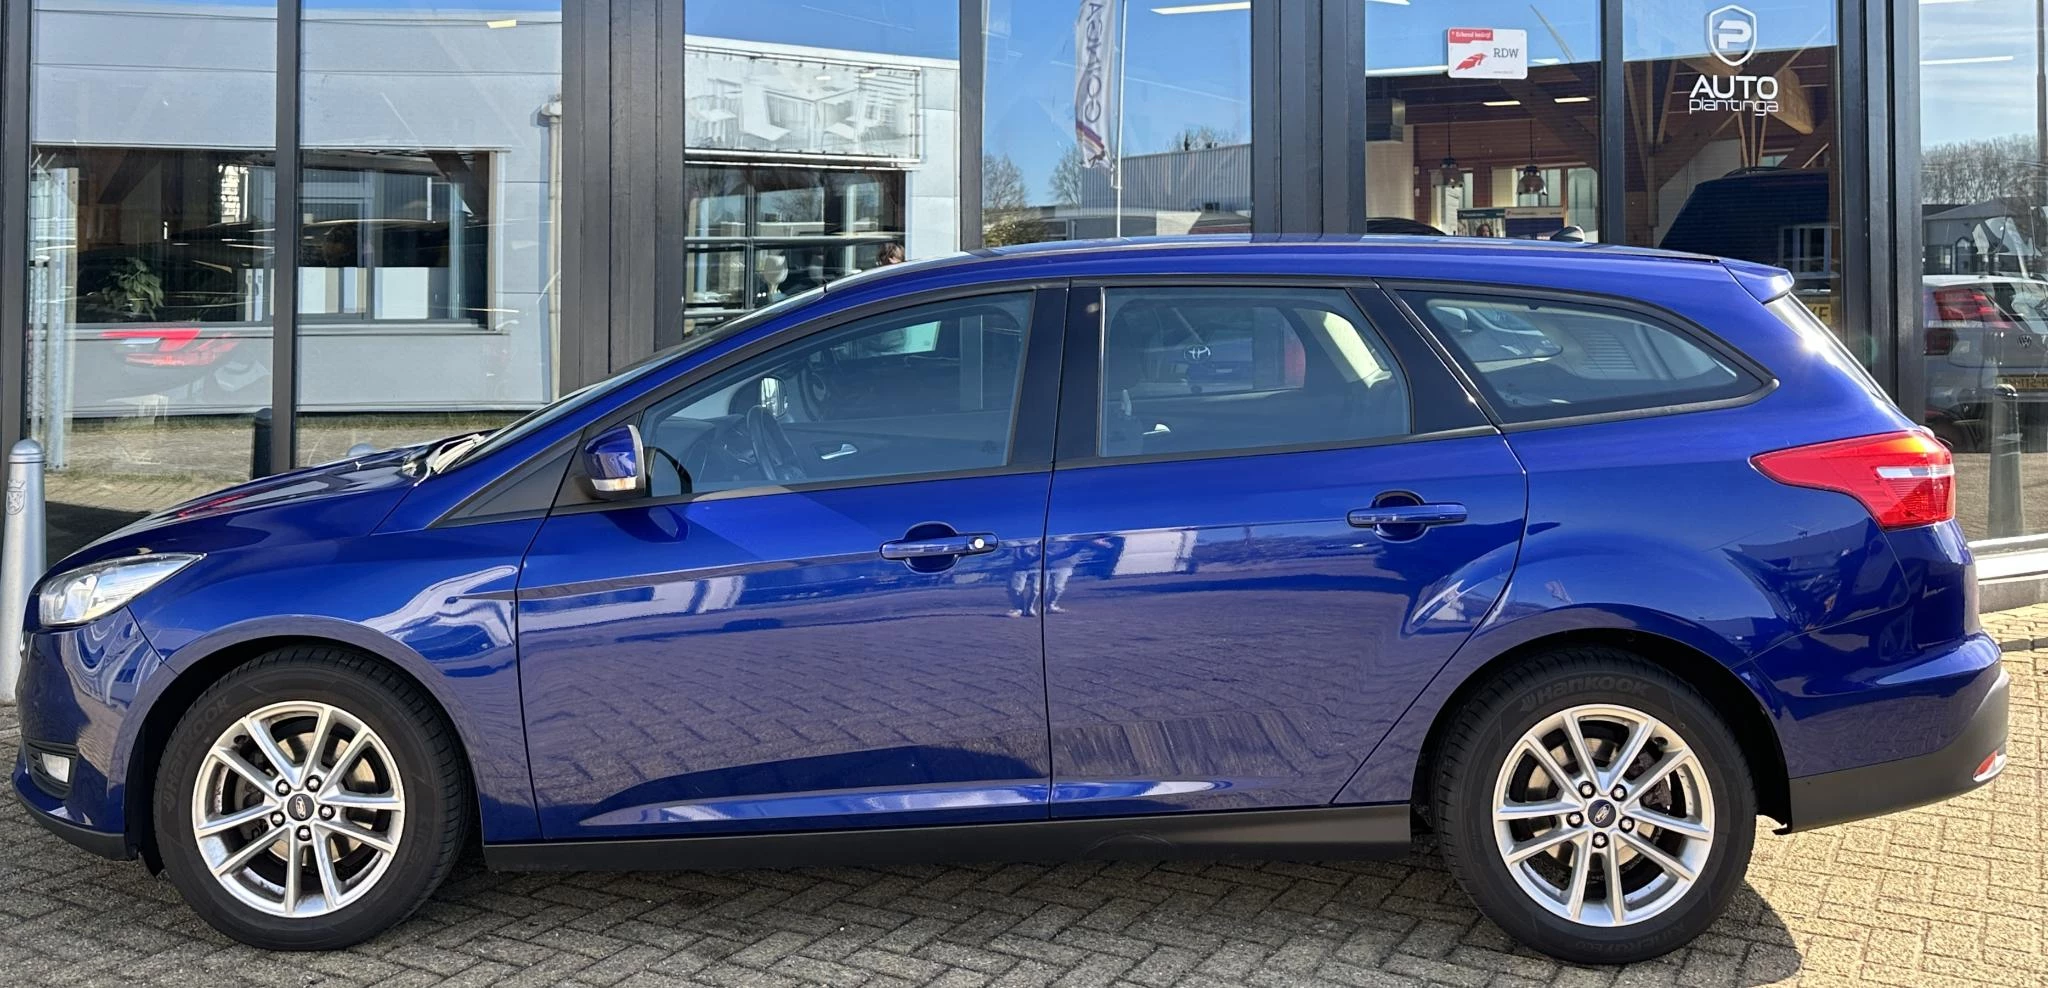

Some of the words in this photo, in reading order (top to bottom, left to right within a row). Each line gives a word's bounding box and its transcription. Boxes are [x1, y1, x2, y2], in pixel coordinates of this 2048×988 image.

[1493, 47, 1519, 58] RDW
[1689, 74, 1778, 99] AUTO
[1689, 97, 1778, 116] plantinga
